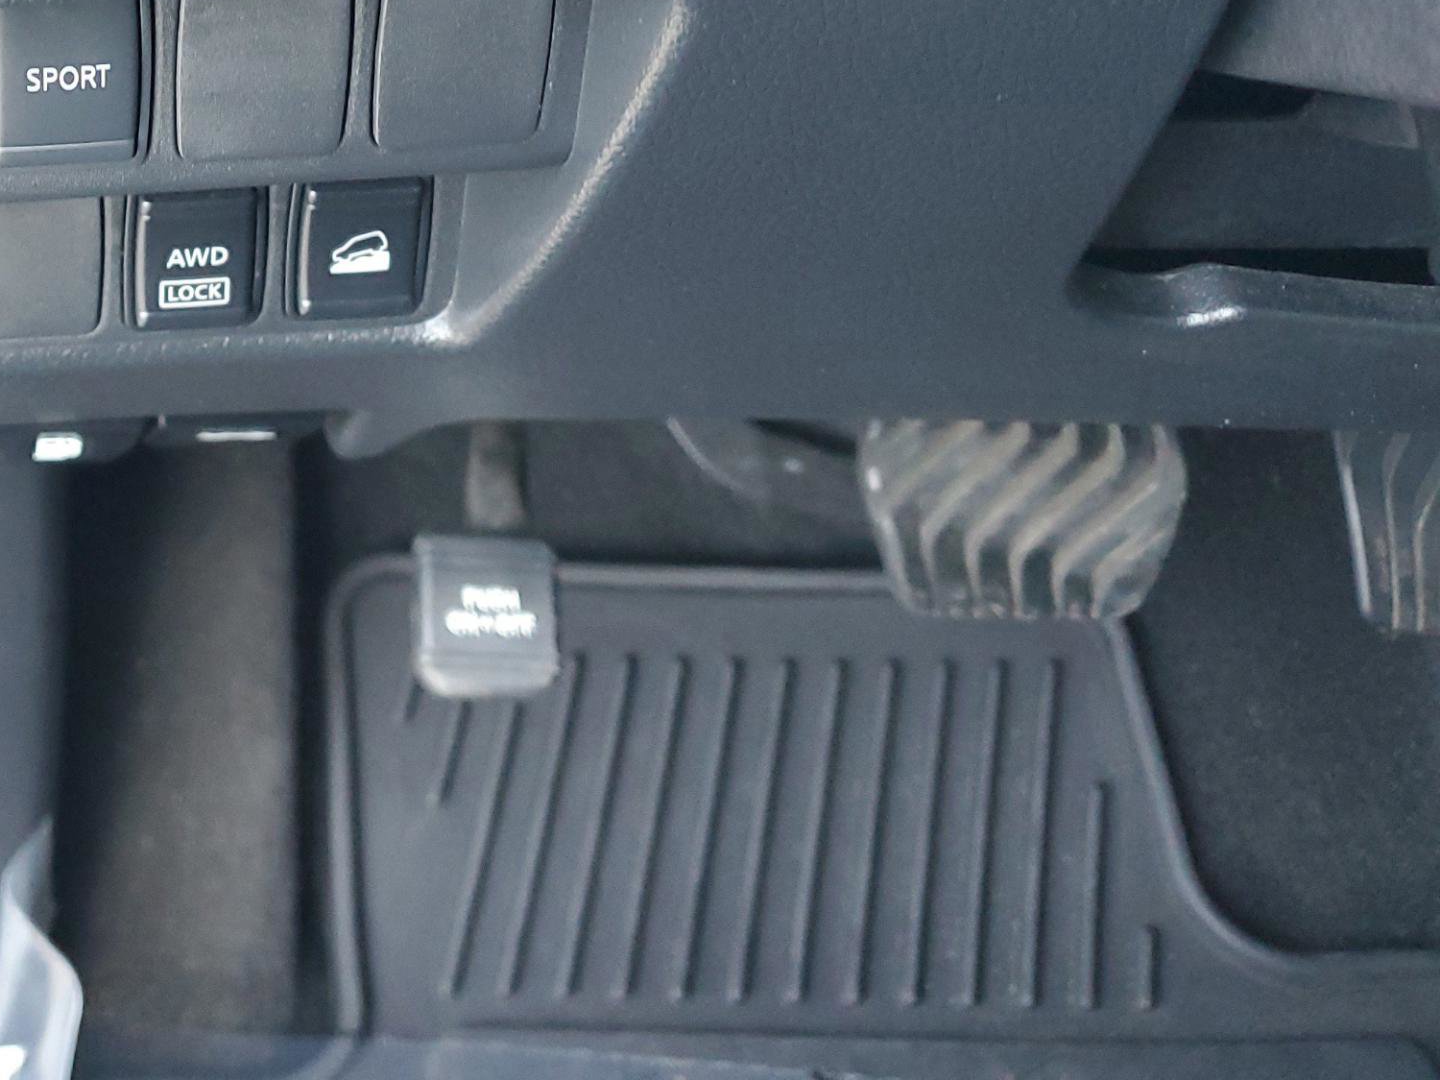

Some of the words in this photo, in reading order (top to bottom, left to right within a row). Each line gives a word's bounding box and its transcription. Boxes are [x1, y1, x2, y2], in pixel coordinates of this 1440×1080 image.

[25, 63, 112, 92] SPORT
[166, 246, 229, 269] AWD
[166, 281, 223, 303] LOCK
